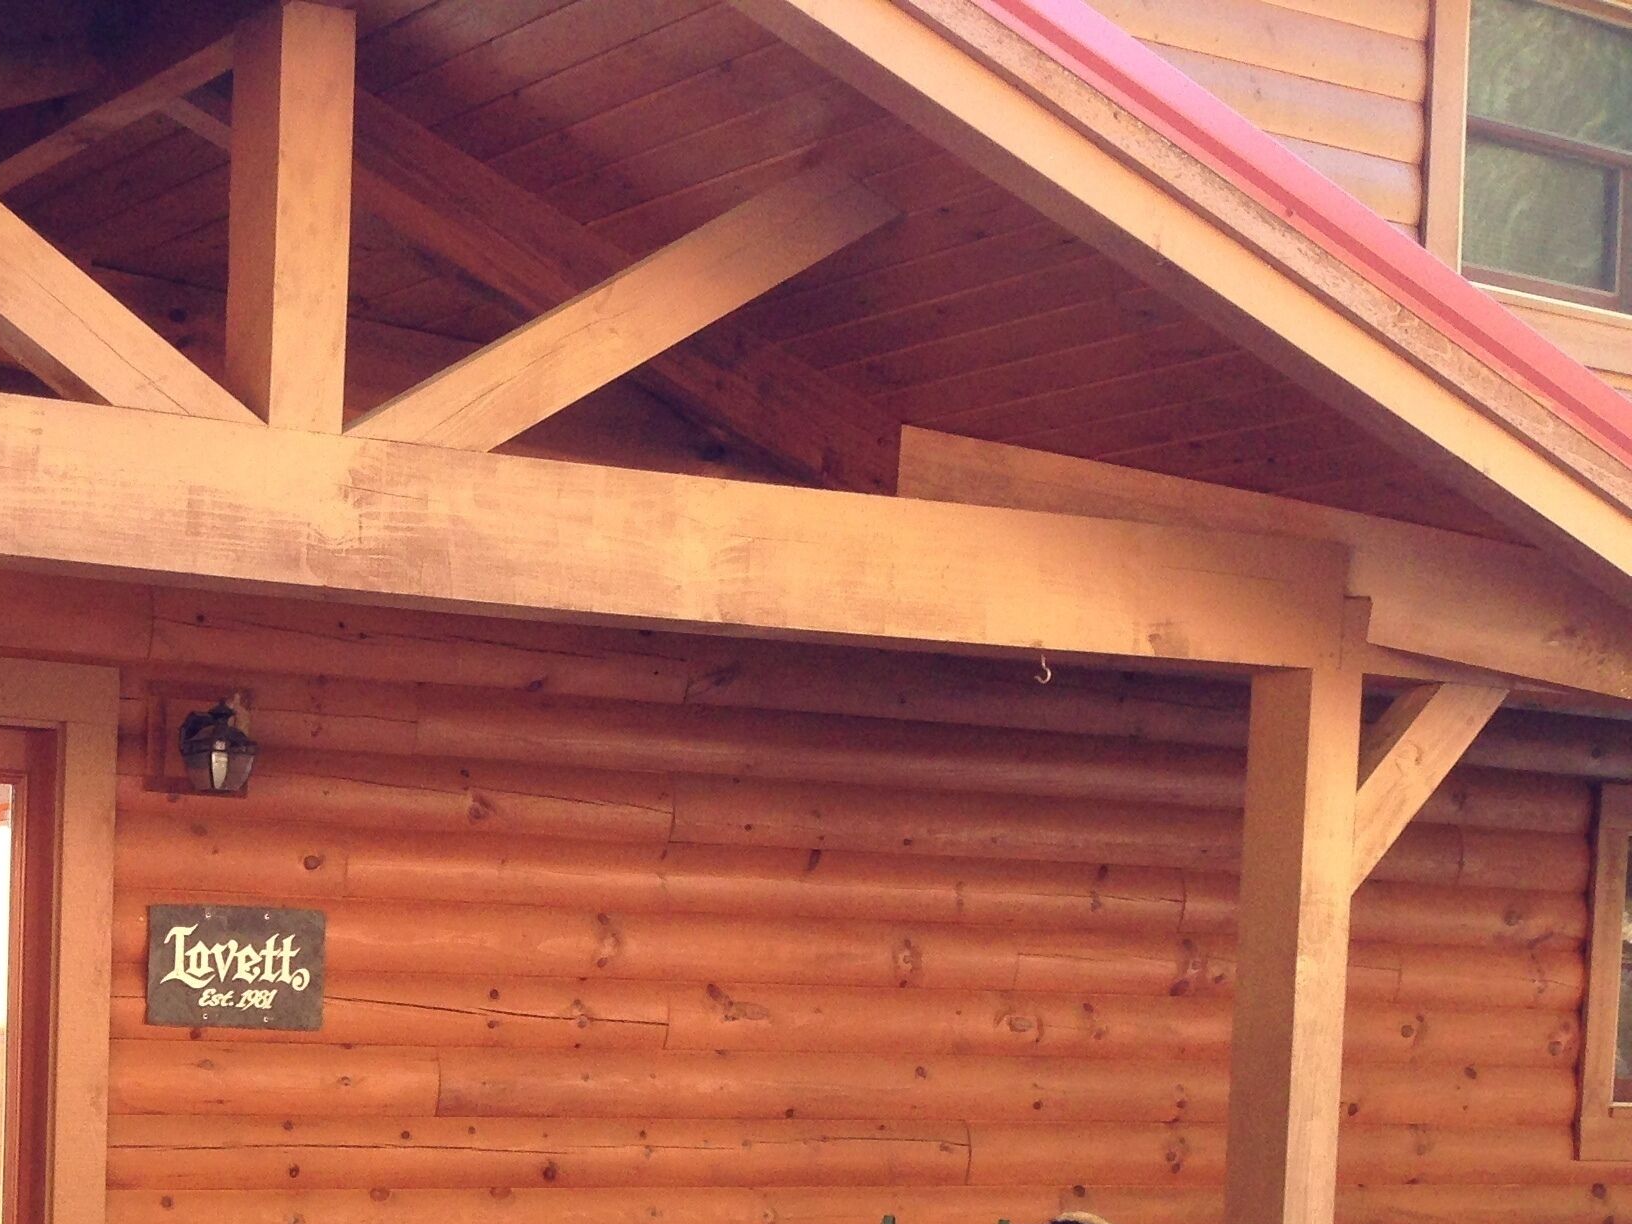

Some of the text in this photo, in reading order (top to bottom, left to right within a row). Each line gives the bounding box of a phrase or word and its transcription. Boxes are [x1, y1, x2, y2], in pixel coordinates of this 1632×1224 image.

[159, 923, 311, 991] Lovett
[198, 988, 278, 1011] Est. 1981
